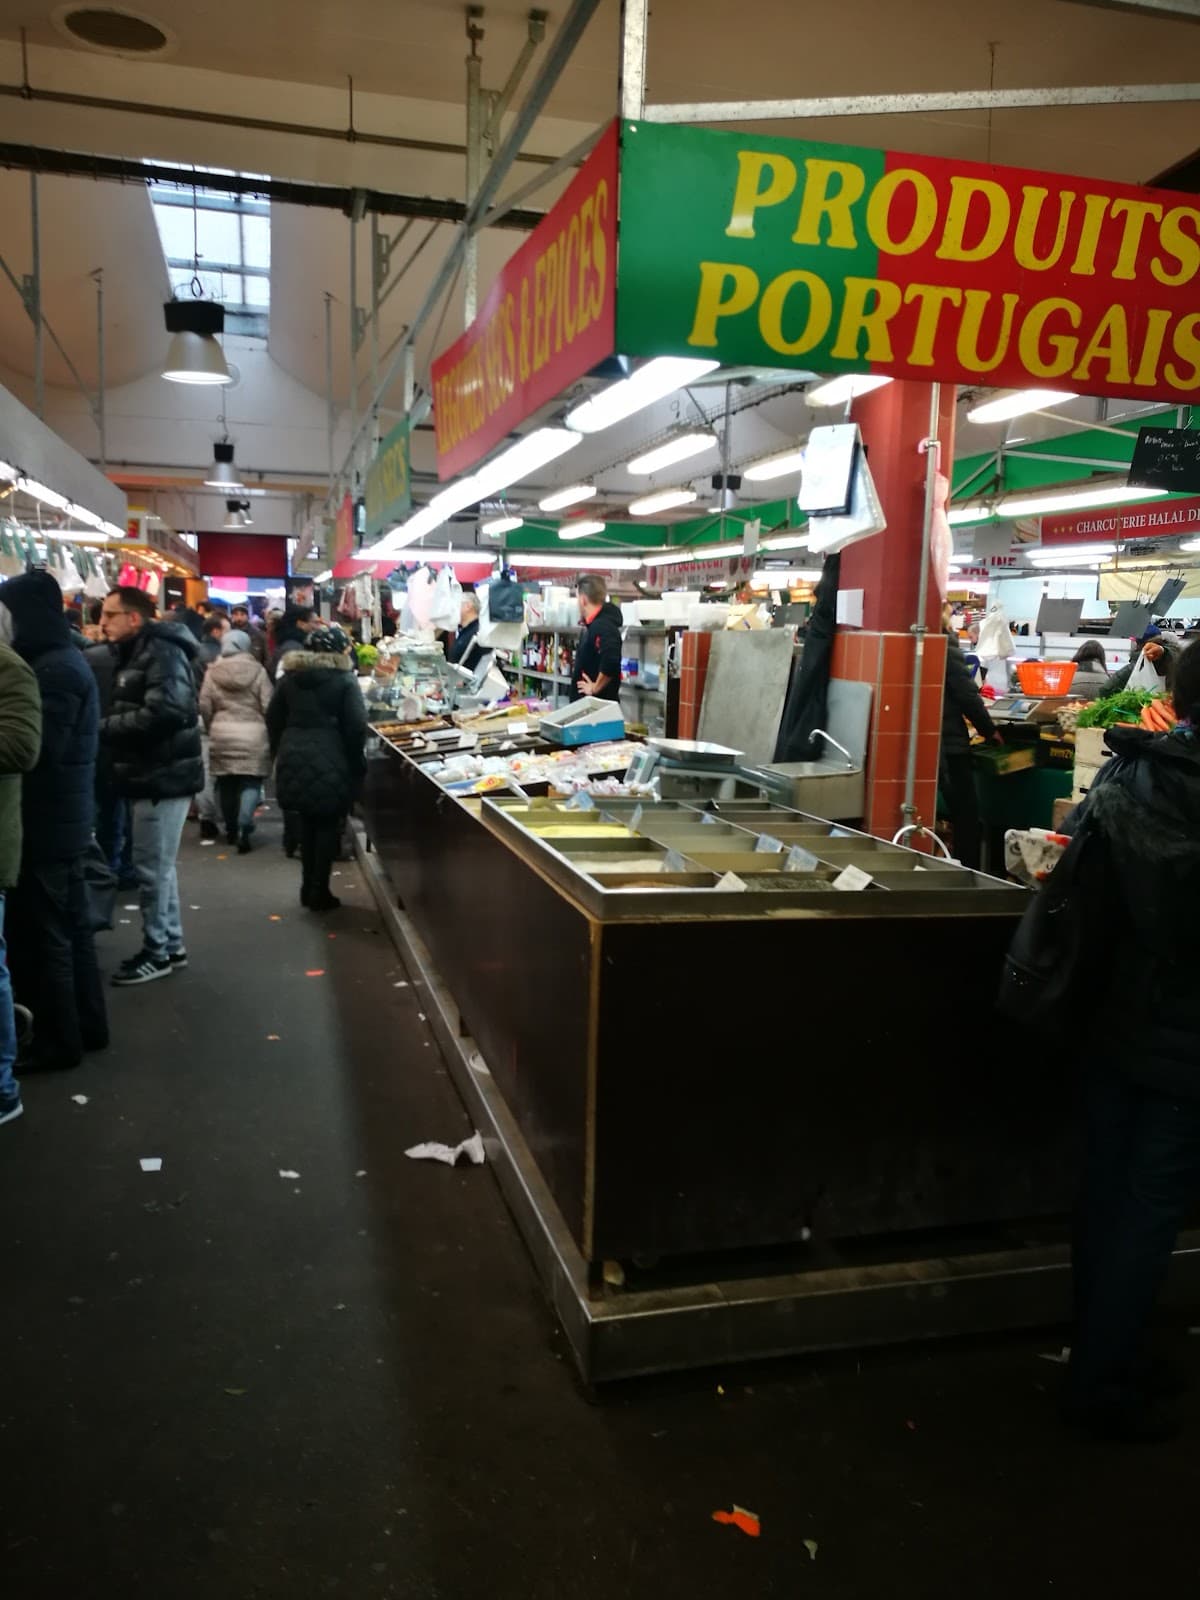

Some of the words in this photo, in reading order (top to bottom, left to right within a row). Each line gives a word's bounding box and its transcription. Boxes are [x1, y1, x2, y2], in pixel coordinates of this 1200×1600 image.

[519, 276, 531, 386] &
[533, 178, 608, 372] EPICES
[724, 149, 1200, 288] PRODUITS
[687, 260, 1200, 392] PORTUGAIS
[1076, 514, 1146, 534] CHARCUTERIE
[1147, 510, 1186, 527] HALAL
